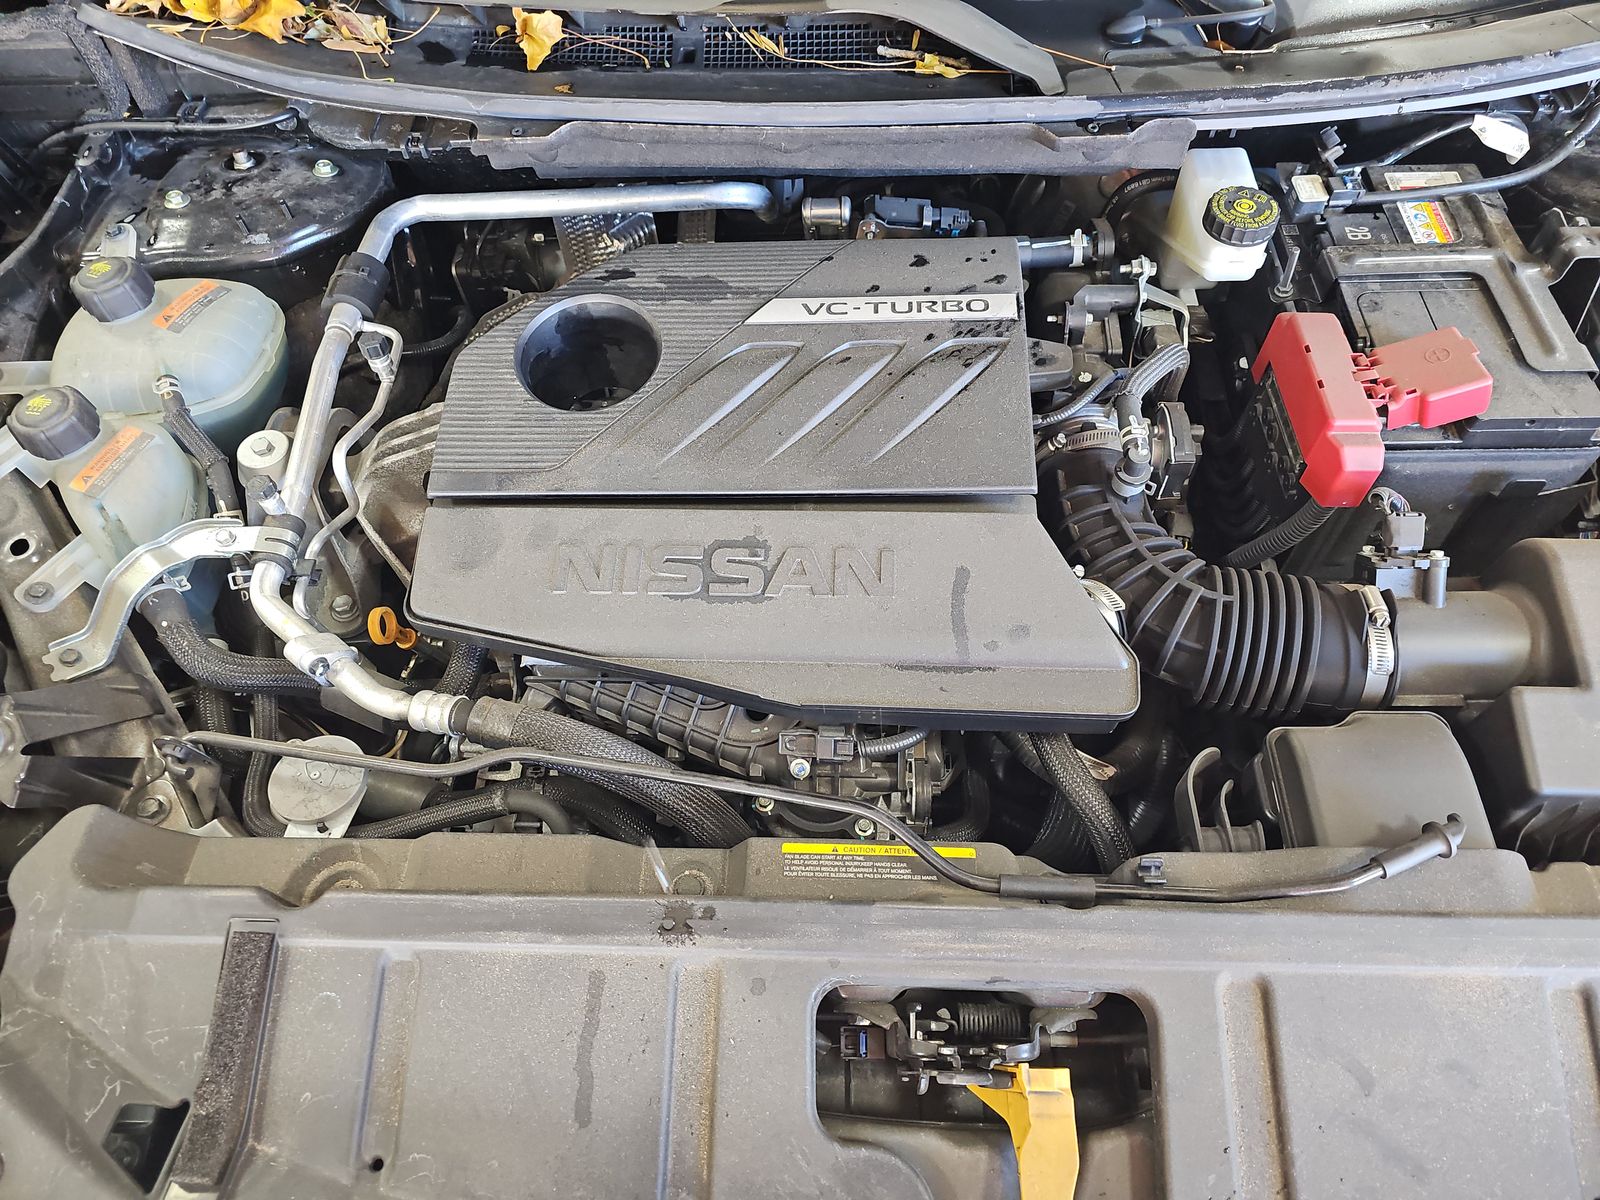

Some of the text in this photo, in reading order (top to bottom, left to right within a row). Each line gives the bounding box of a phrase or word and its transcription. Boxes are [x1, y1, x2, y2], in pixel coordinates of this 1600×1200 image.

[1344, 227, 1372, 240] 2B
[801, 298, 989, 315] VC-TURBO
[551, 544, 896, 598] NISSAN
